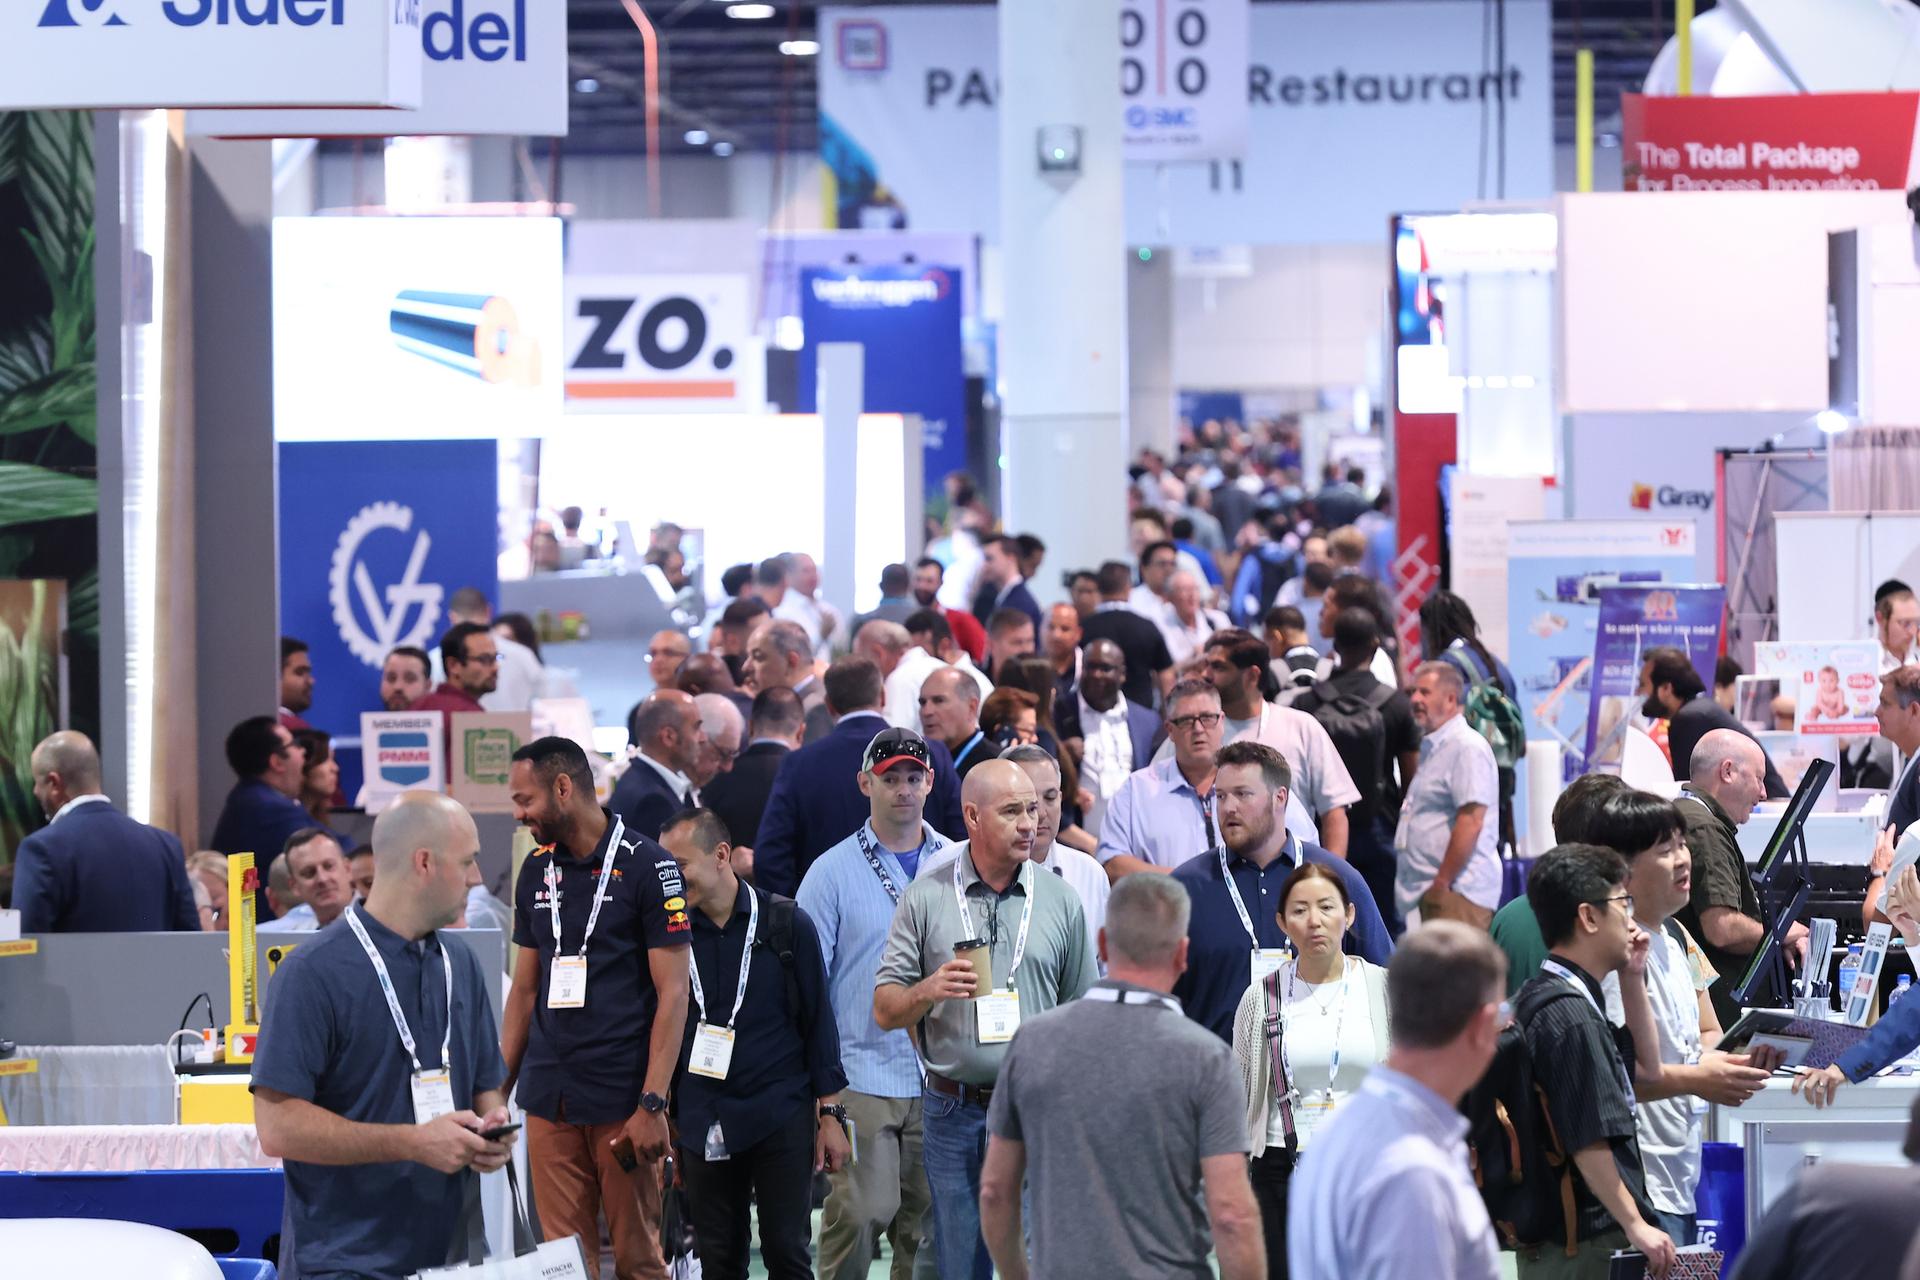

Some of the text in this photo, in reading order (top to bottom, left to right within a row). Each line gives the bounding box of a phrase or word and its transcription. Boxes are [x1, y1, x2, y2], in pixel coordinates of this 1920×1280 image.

[925, 63, 1523, 109] PA Restaurant
[1636, 142, 1860, 174] The Total Package
[1657, 485, 1714, 511] Gray
